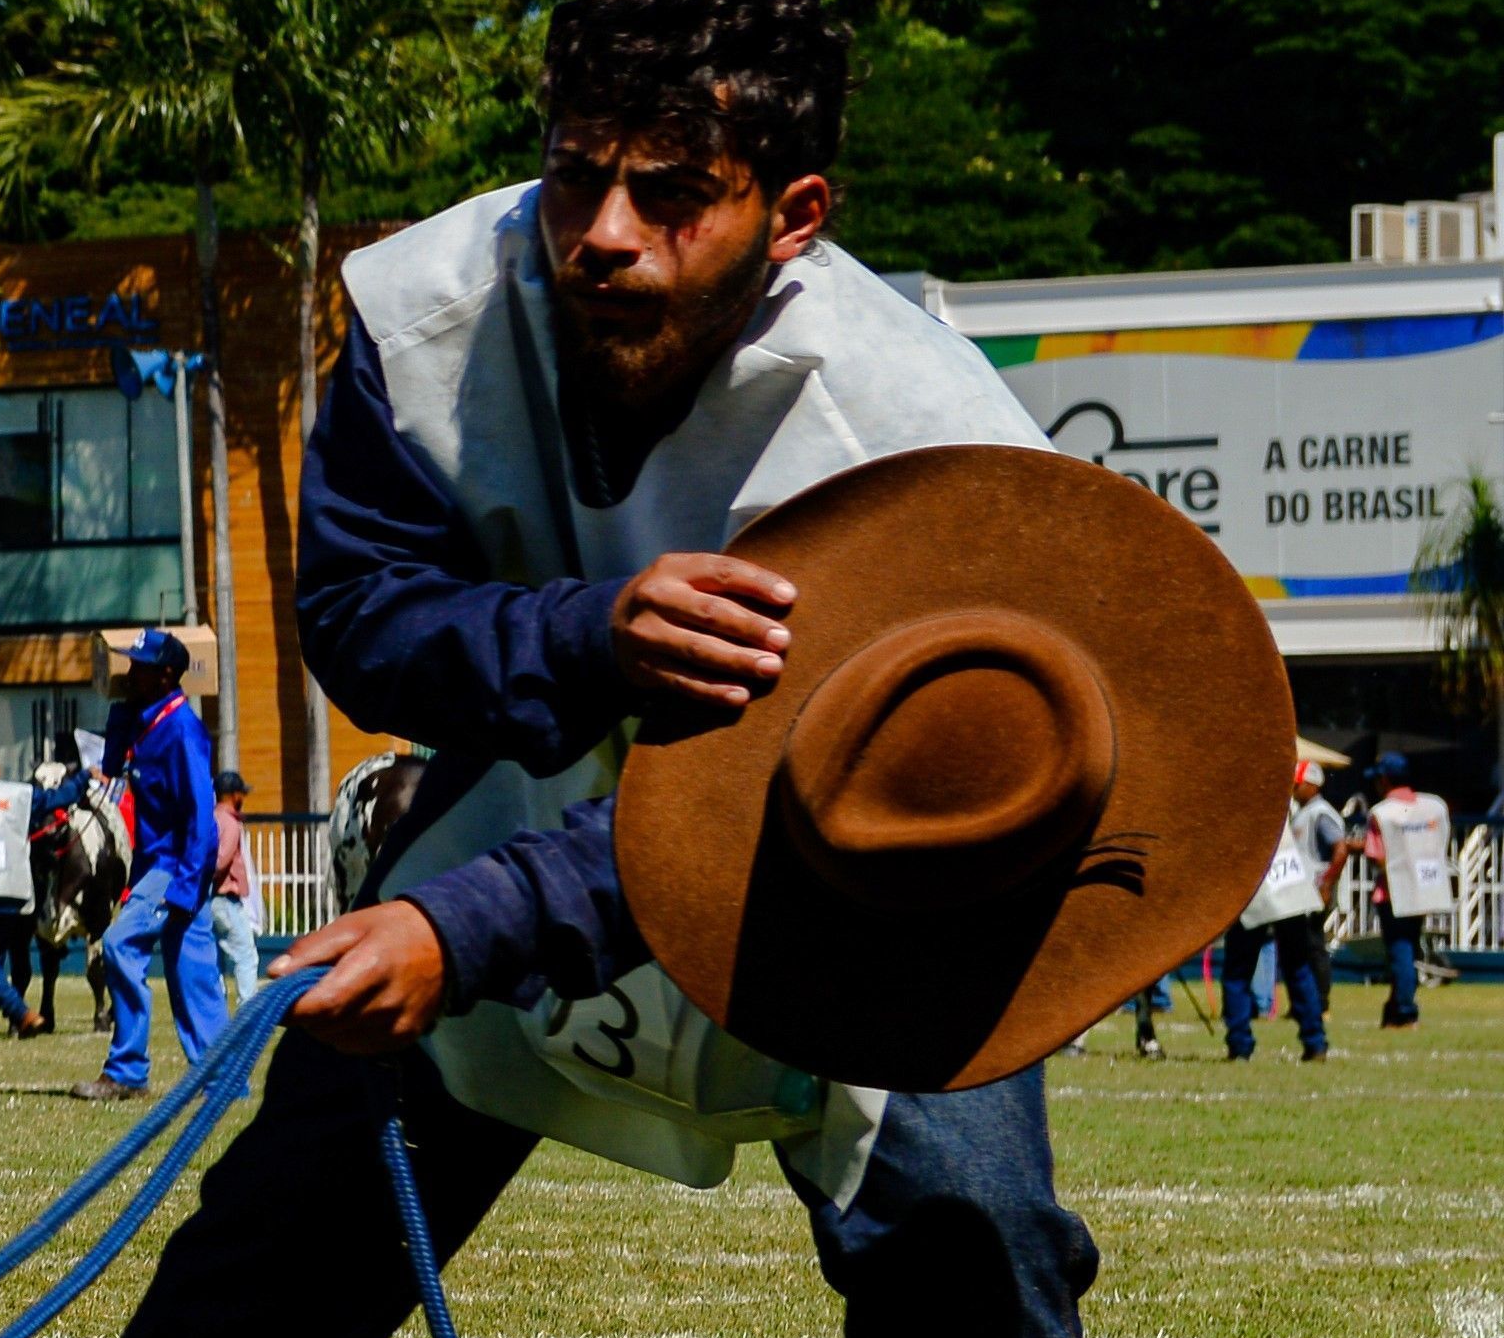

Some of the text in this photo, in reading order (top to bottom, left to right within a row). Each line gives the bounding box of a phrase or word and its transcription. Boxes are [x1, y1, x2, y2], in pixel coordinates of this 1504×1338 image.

[1262, 433, 1412, 472] A CARNE
[1265, 487, 1445, 525] DO BRASIL
